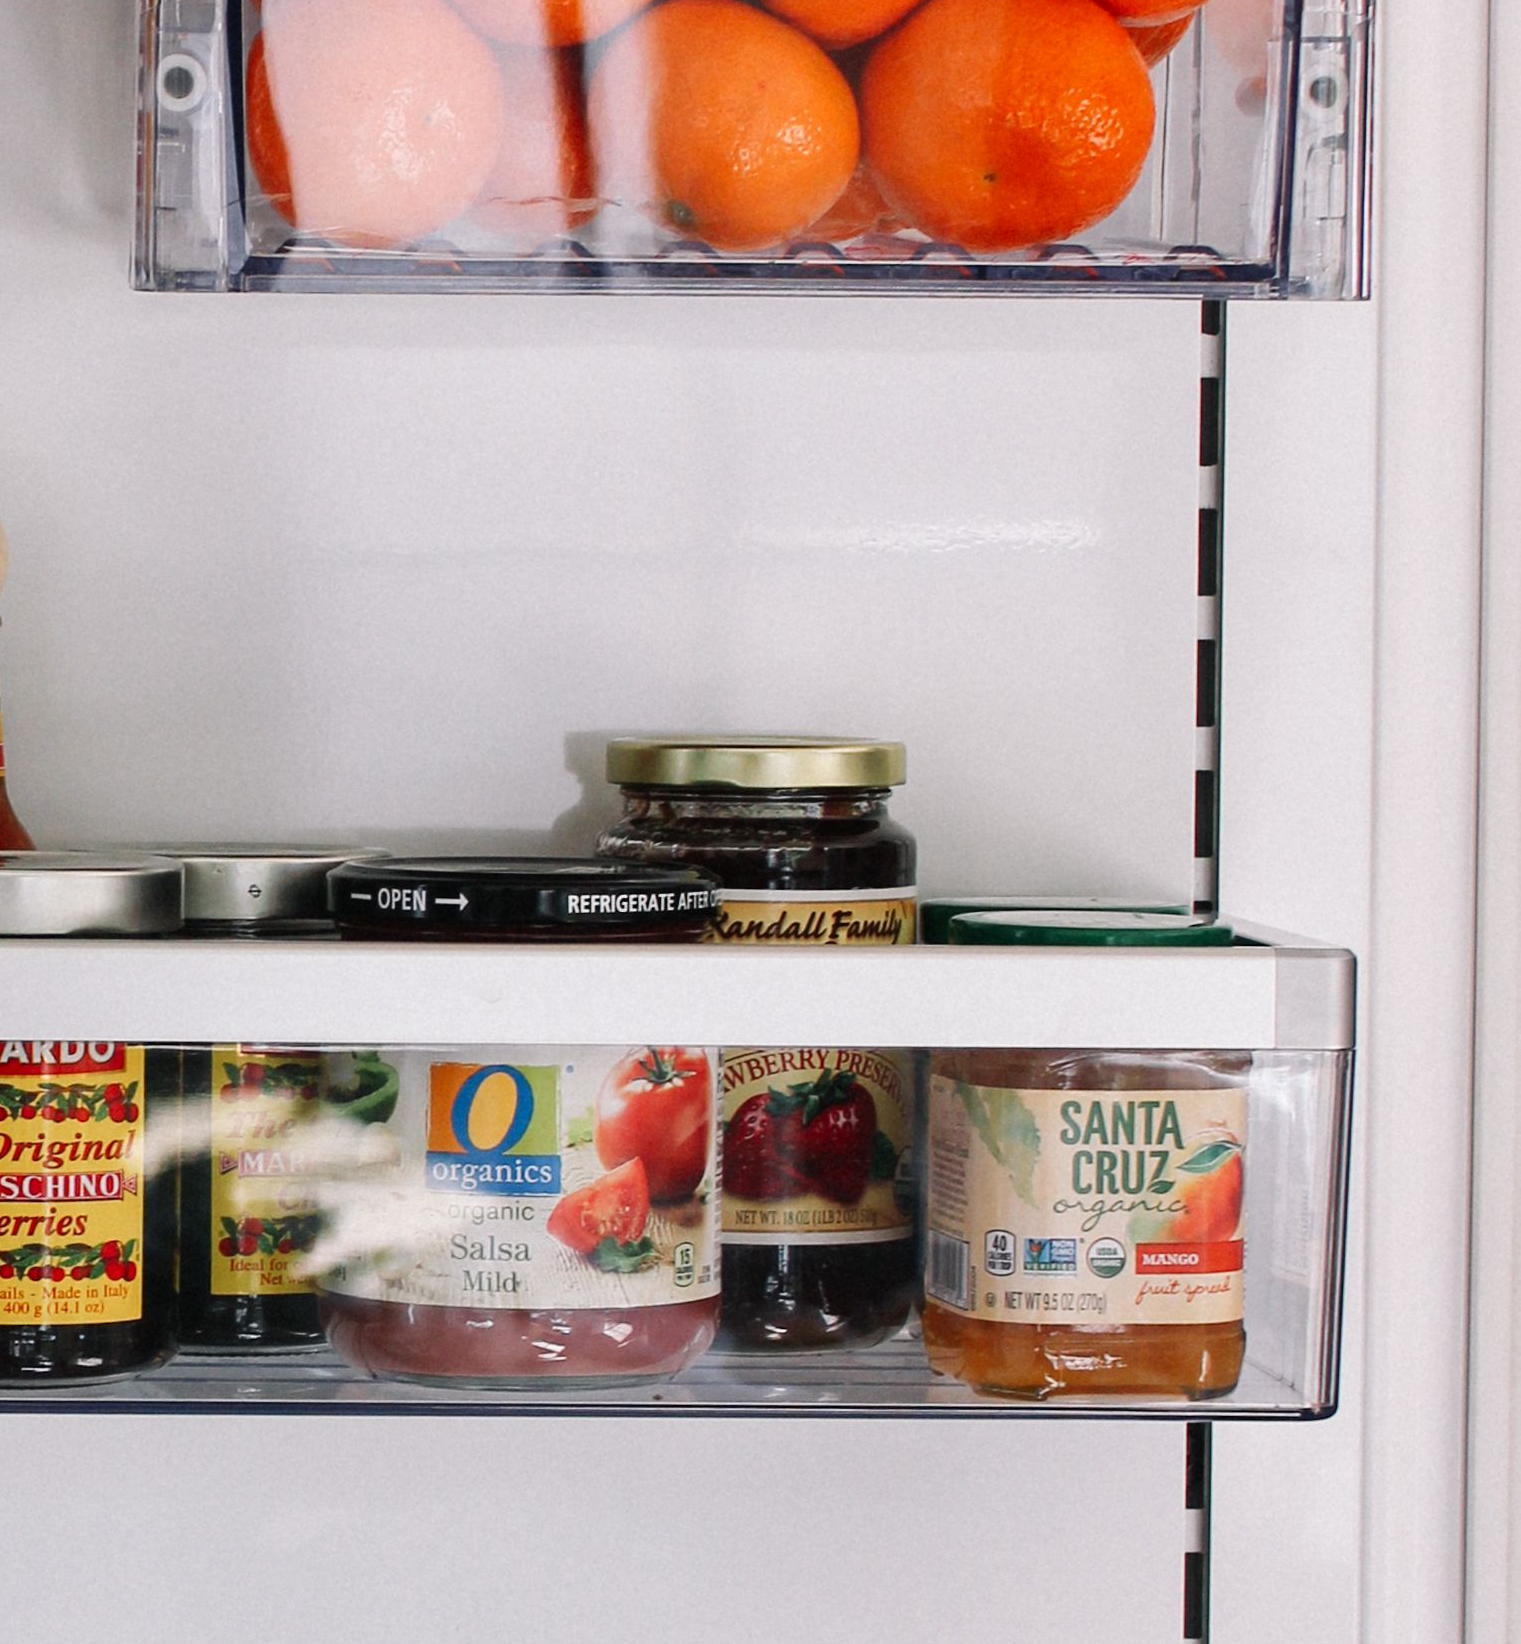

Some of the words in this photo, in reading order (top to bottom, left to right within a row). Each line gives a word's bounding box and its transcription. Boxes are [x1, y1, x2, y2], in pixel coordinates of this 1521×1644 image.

[378, 887, 427, 913] OPEN
[568, 893, 674, 914] REFRIGERATE
[677, 891, 709, 910] AFTER
[828, 909, 902, 944] Family
[1060, 1101, 1184, 1150] SANTA
[433, 1159, 552, 1188] organics
[1072, 1150, 1170, 1195] CRUZ
[449, 1200, 534, 1224] organic
[450, 1235, 532, 1261] Salsa
[992, 1235, 1007, 1251] 40
[1142, 1253, 1199, 1265] MANGO
[43, 1285, 80, 1298] Made
[3, 1301, 29, 1314] 400
